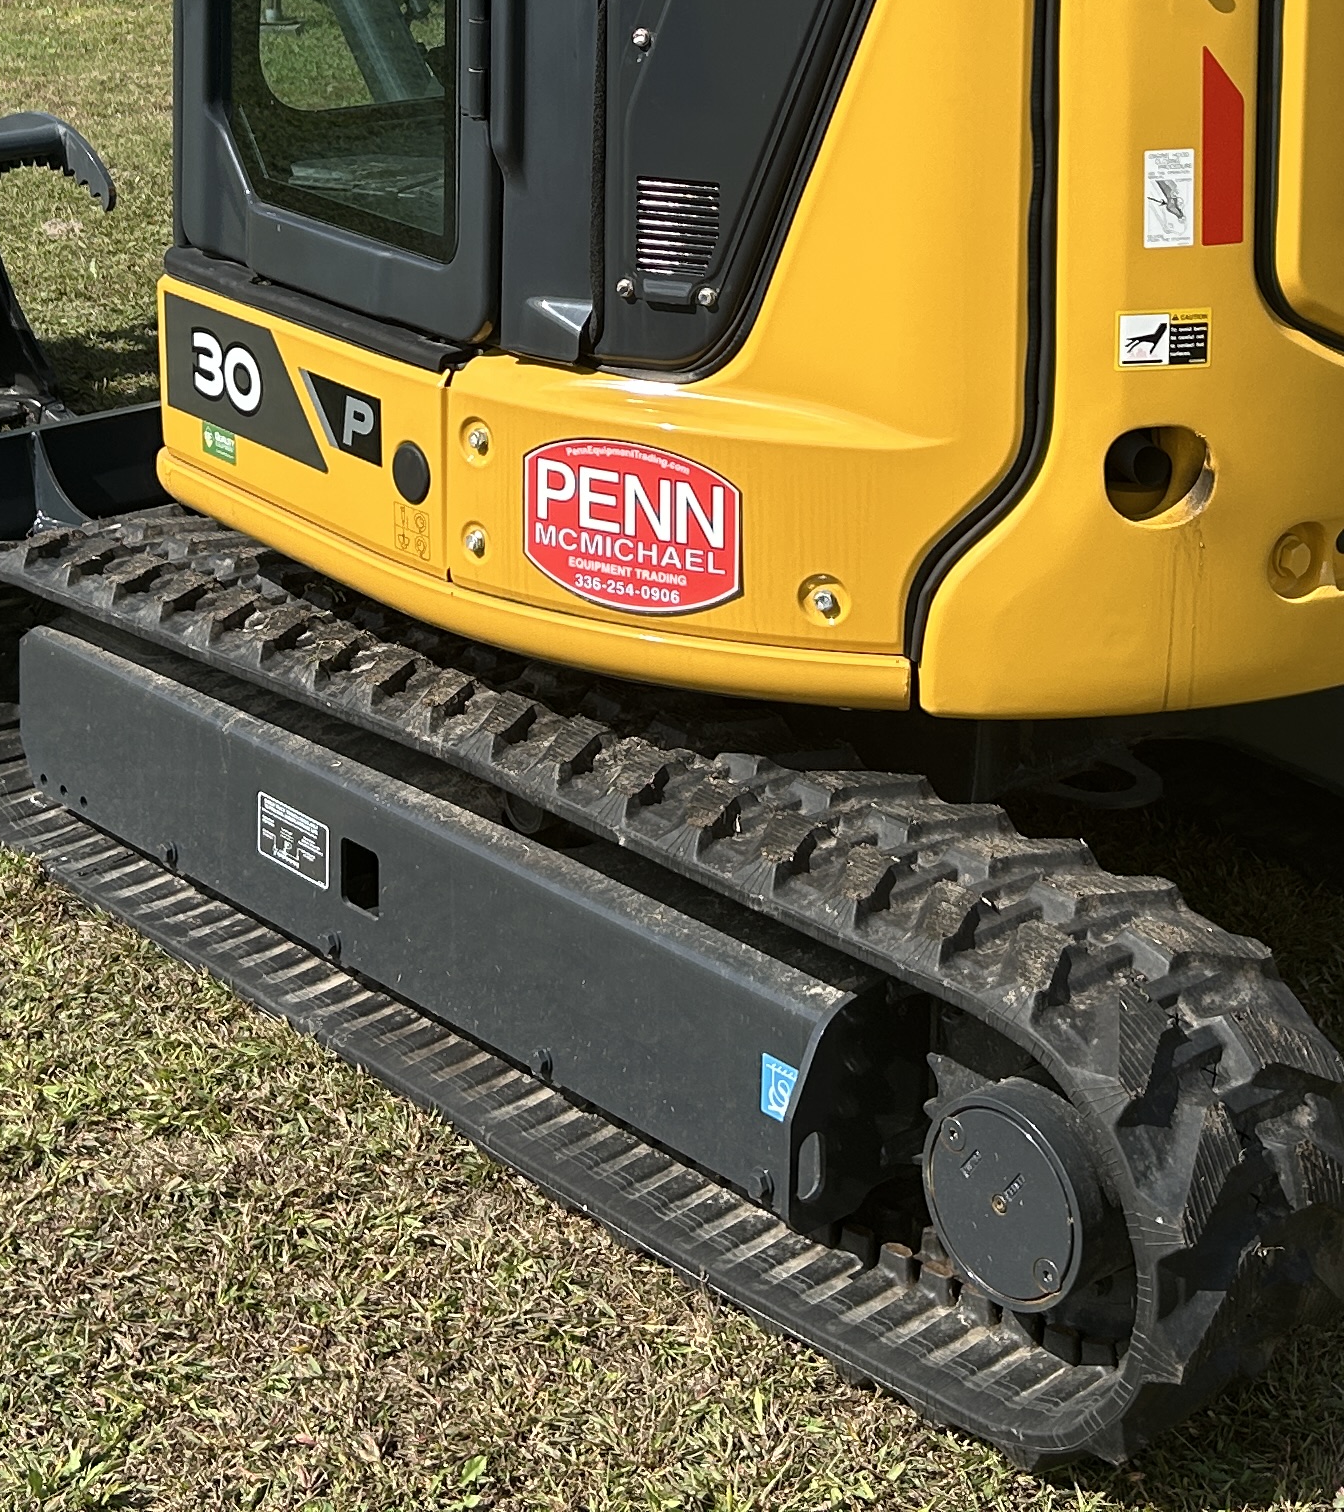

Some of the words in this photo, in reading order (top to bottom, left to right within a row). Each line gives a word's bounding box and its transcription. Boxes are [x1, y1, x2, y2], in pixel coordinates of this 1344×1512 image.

[1179, 313, 1208, 321] CAUTION
[192, 329, 262, 414] 30
[342, 395, 375, 447] P
[536, 456, 726, 550] PENN
[534, 522, 727, 575] MCMICHAEL
[567, 555, 633, 578] EQUIPMENT
[634, 567, 688, 587] TRADING
[574, 573, 681, 605] 336-254-0906
